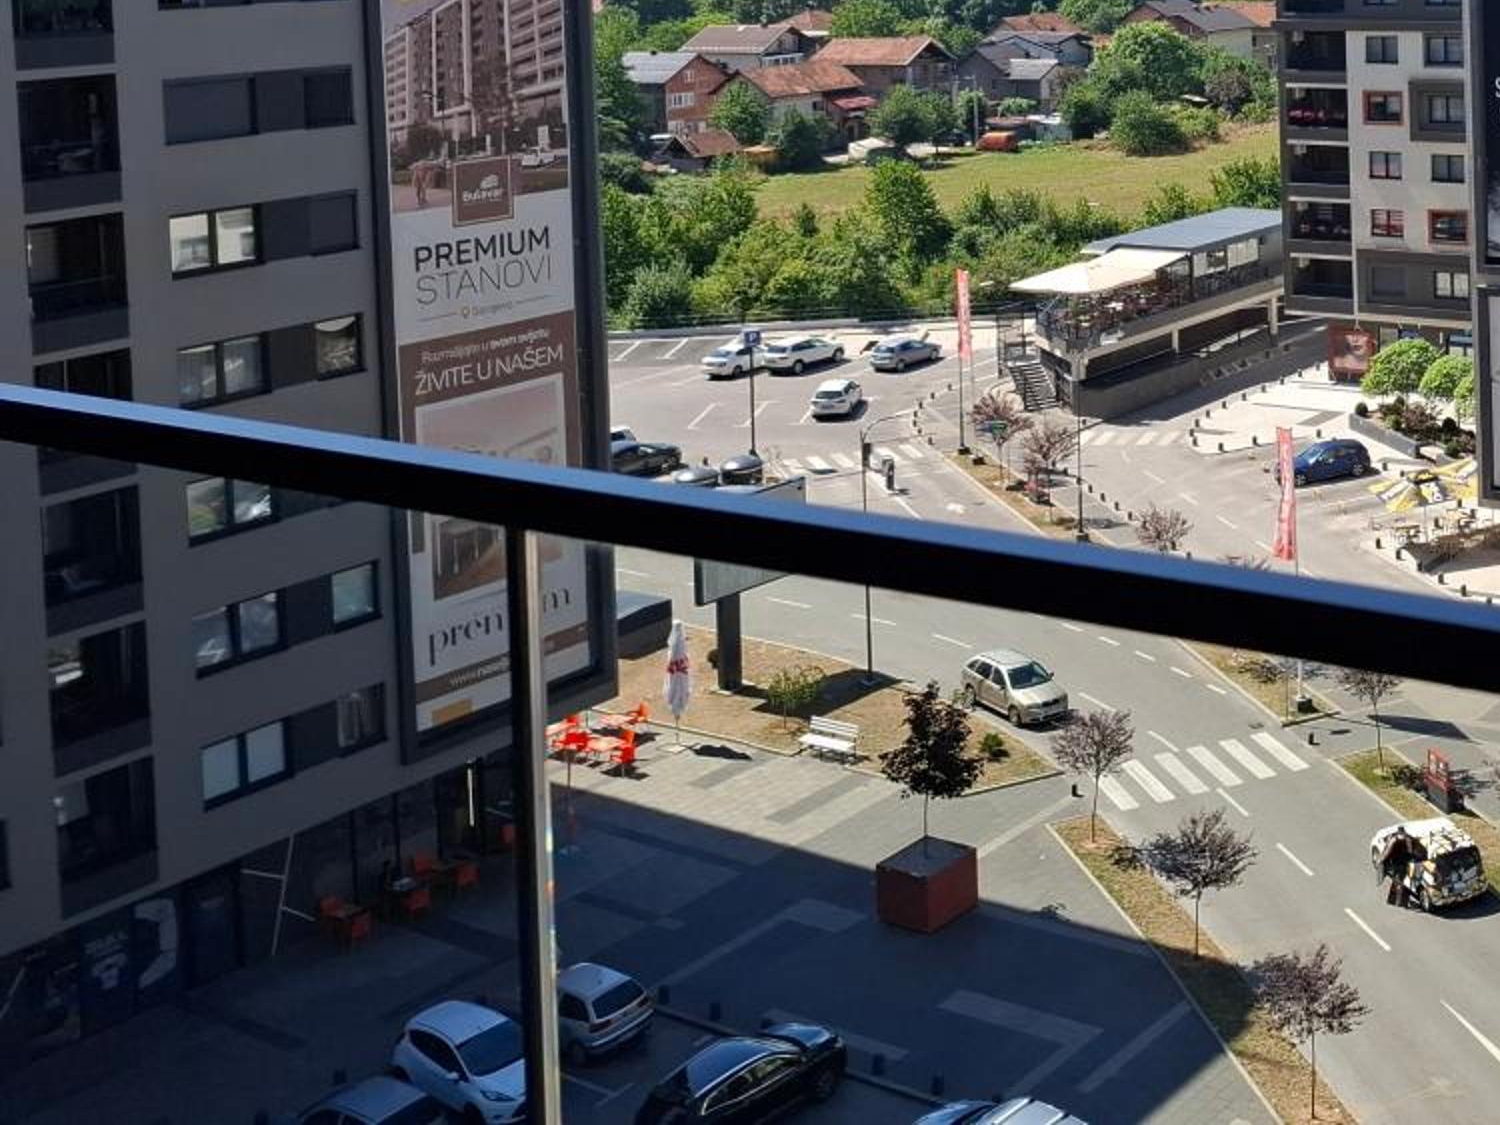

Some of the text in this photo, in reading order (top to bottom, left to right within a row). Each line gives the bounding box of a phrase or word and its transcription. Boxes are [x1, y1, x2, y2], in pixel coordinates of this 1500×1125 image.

[414, 226, 551, 273] PREMIUM
[415, 254, 553, 307] STANOVI
[415, 363, 475, 396] ŽIVITE
[477, 361, 491, 380] U
[495, 343, 564, 378] NAŠEM
